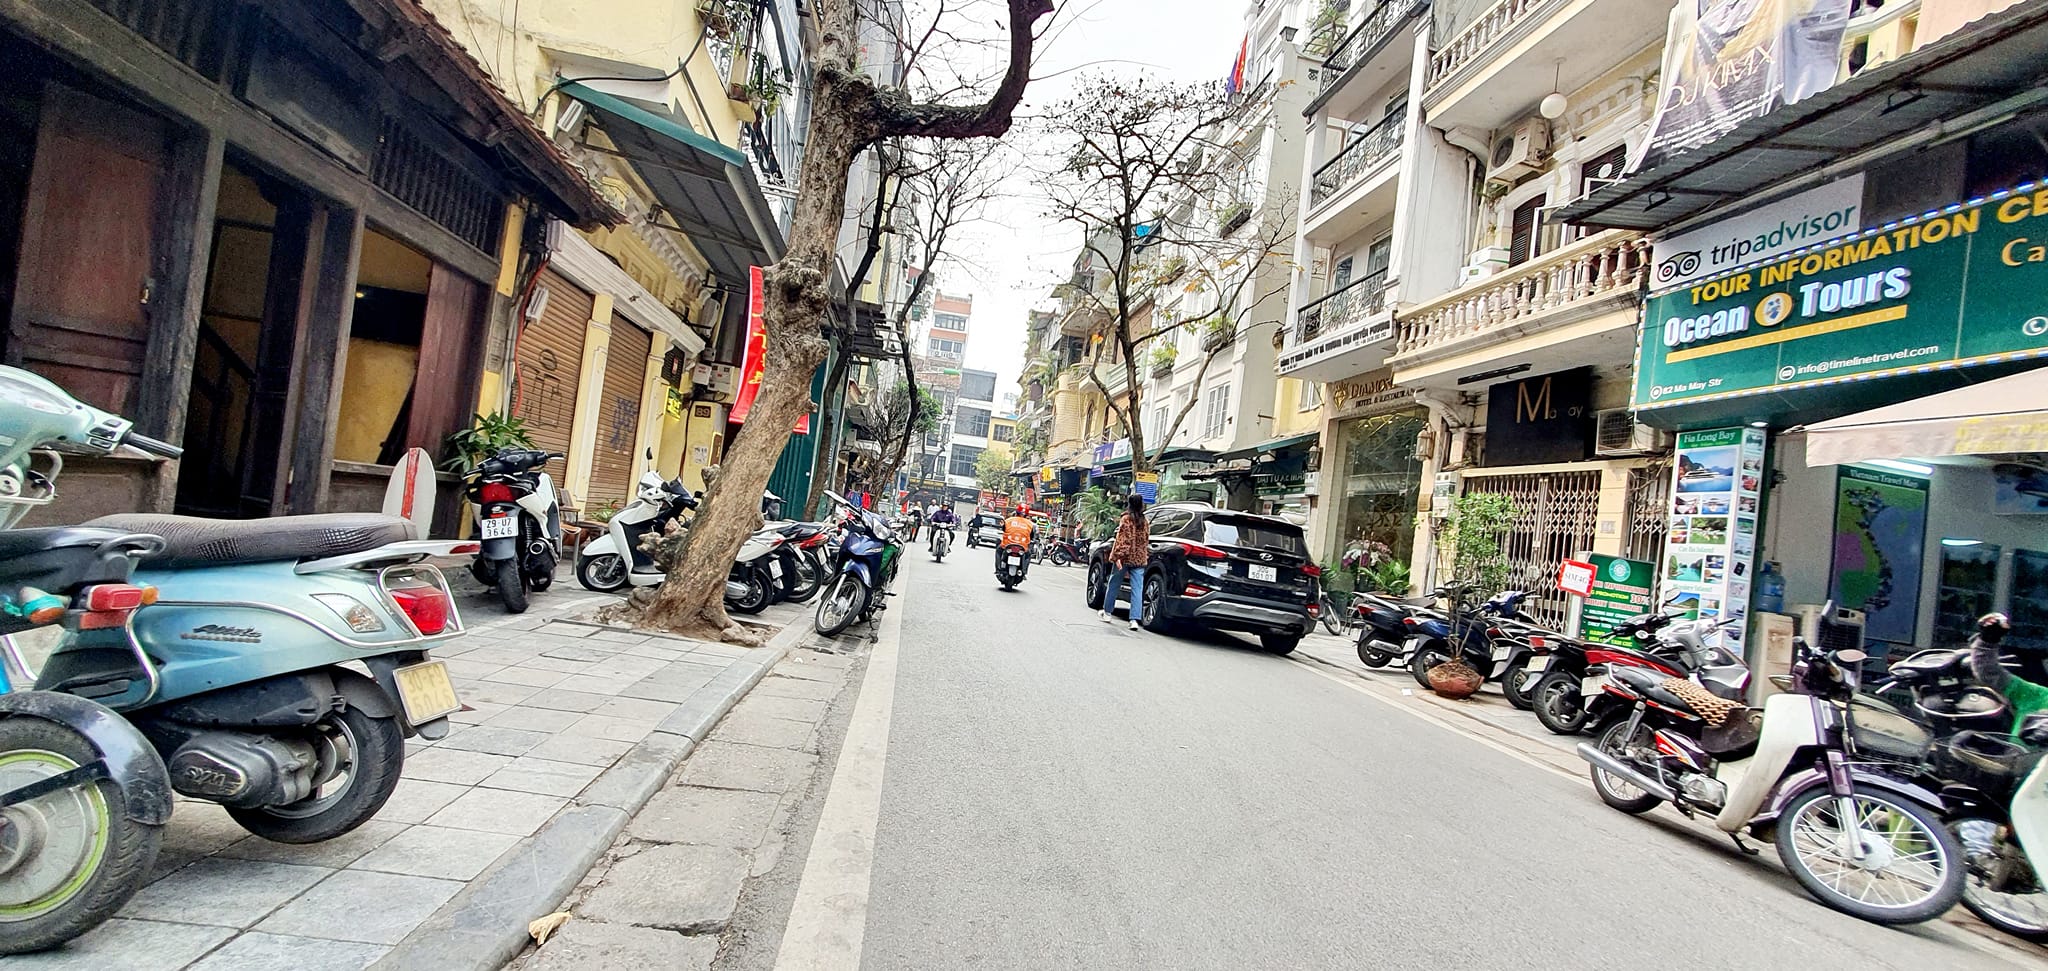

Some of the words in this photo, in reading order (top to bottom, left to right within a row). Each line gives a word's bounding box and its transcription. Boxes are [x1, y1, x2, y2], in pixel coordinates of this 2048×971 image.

[1711, 206, 1856, 265] tripadvisor
[1691, 273, 1751, 304] TOUR
[1760, 209, 1980, 287] INFORMATION
[1663, 305, 1749, 347] Ocean
[1800, 267, 1911, 317] Tours
[1797, 345, 1939, 374] info@timelinetravel.com
[1688, 382, 1707, 390] May
[1708, 378, 1723, 387] Str
[696, 407, 711, 417] 89
[1696, 433, 1717, 442] Long
[1718, 431, 1736, 441] Bay
